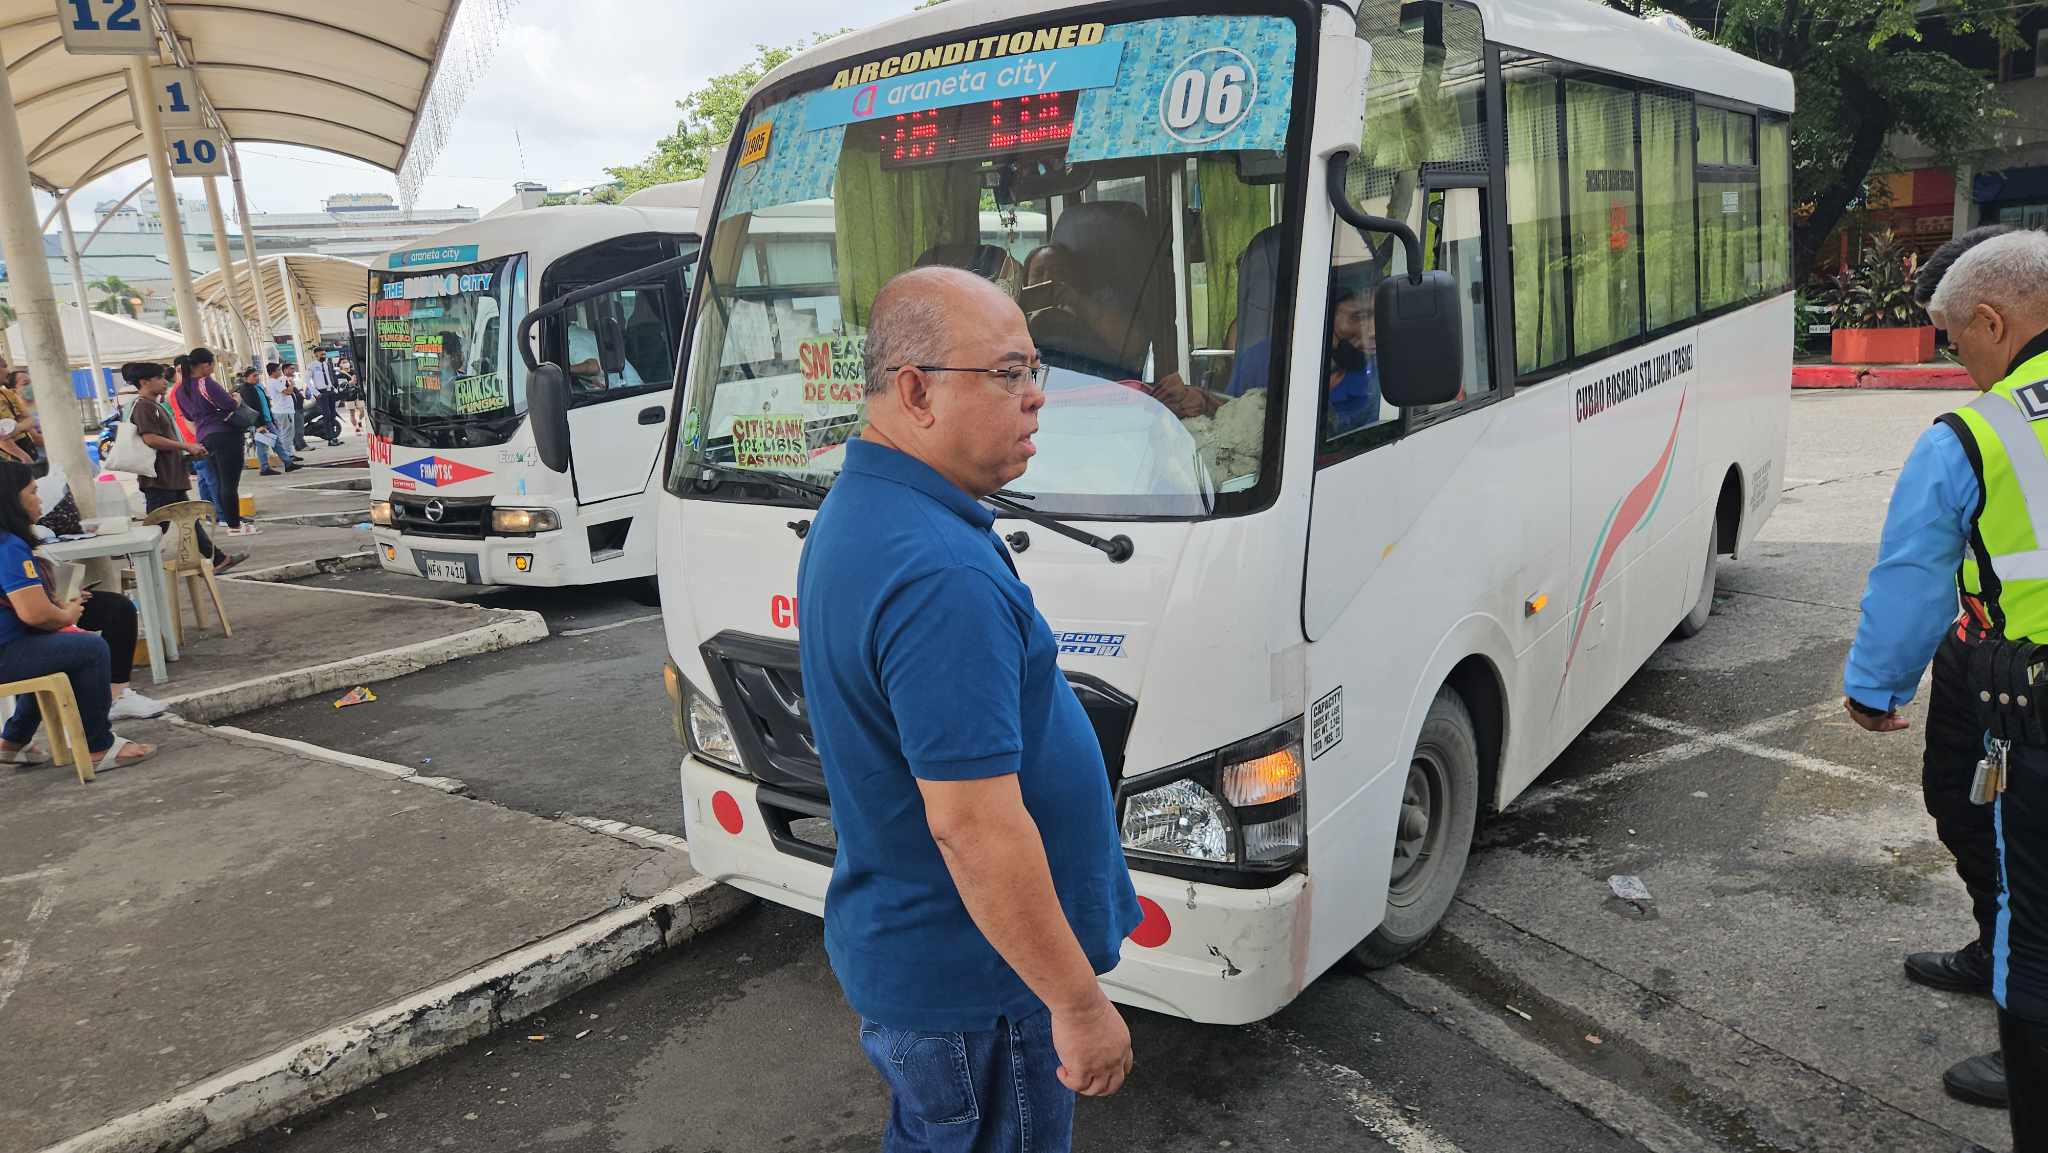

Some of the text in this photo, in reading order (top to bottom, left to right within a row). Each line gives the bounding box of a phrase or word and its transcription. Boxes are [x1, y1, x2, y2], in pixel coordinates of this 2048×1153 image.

[69, 0, 141, 31] 12
[832, 23, 1104, 89] AIRCONDITIONED
[887, 58, 1056, 106] araneta city
[1167, 65, 1247, 129] 06
[172, 139, 217, 164] 10
[442, 247, 460, 260] city
[383, 281, 404, 299] THE
[460, 273, 493, 292] CITY
[800, 339, 864, 380] SM EAS
[804, 383, 864, 401] DE CAS
[1576, 379, 1604, 423] CUBAO
[1606, 365, 1638, 408] ROSARIO
[733, 419, 804, 440] CITIBANK
[738, 453, 808, 466] EASTWOOD
[445, 566, 465, 580] 7410
[1063, 633, 1123, 643] POWER
[1313, 690, 1340, 717] CAPACITY
